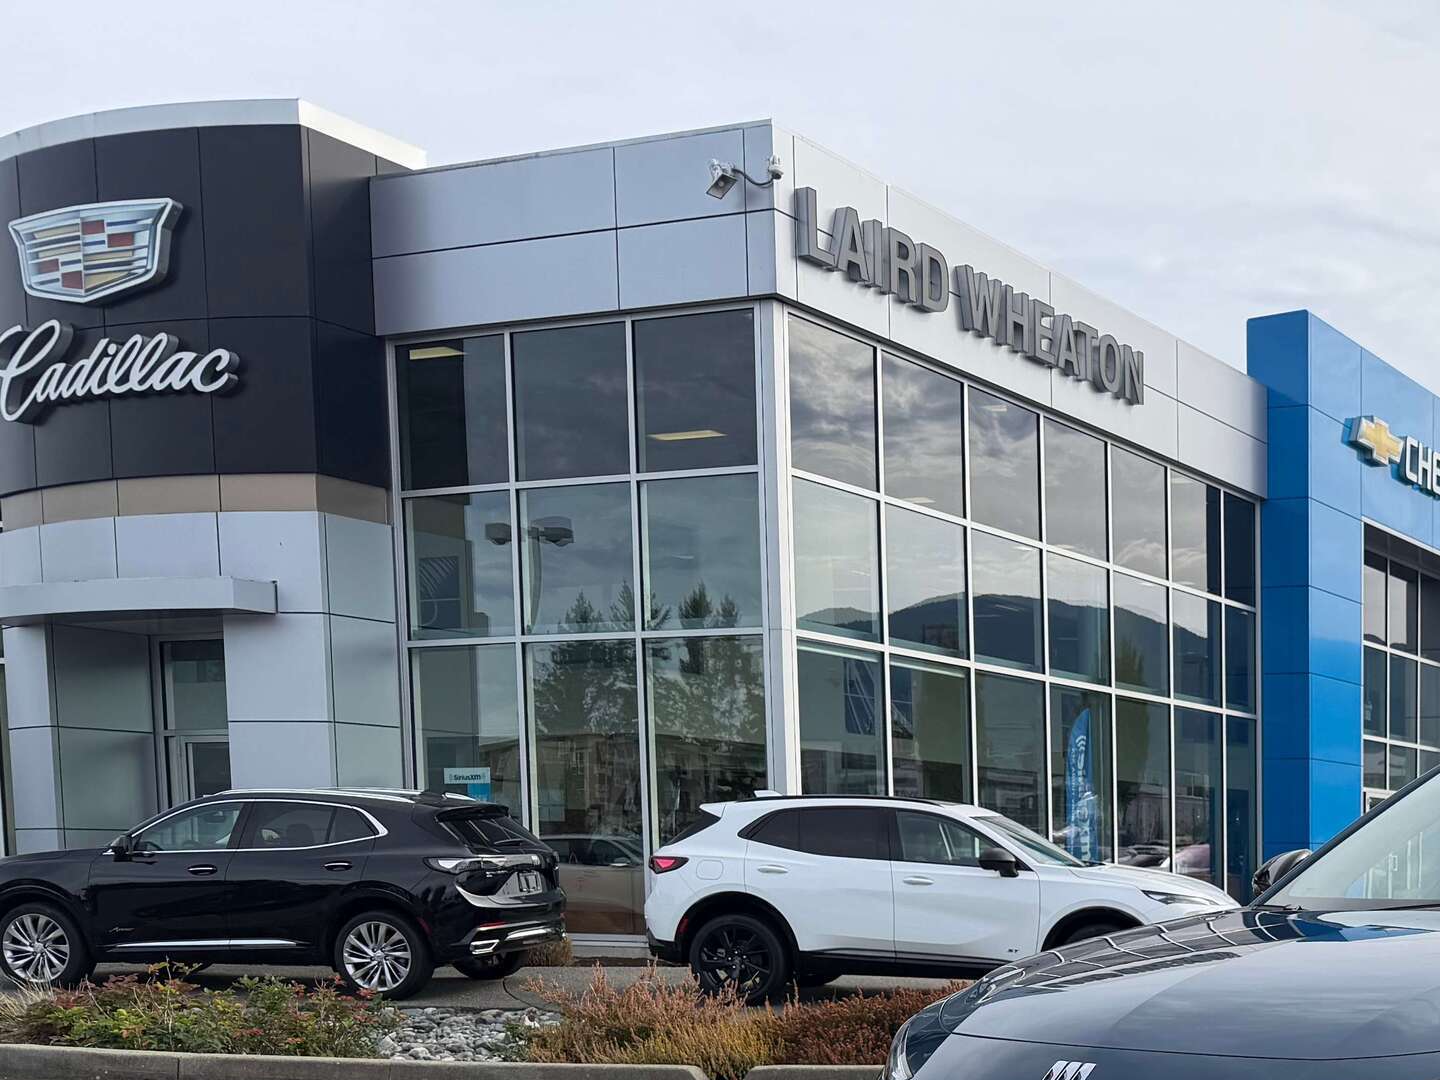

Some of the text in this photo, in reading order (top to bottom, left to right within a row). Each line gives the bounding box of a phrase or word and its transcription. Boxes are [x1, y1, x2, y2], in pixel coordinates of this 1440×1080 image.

[0, 319, 236, 422] Cadillac
[793, 186, 1144, 406] LAIRD WHEATON
